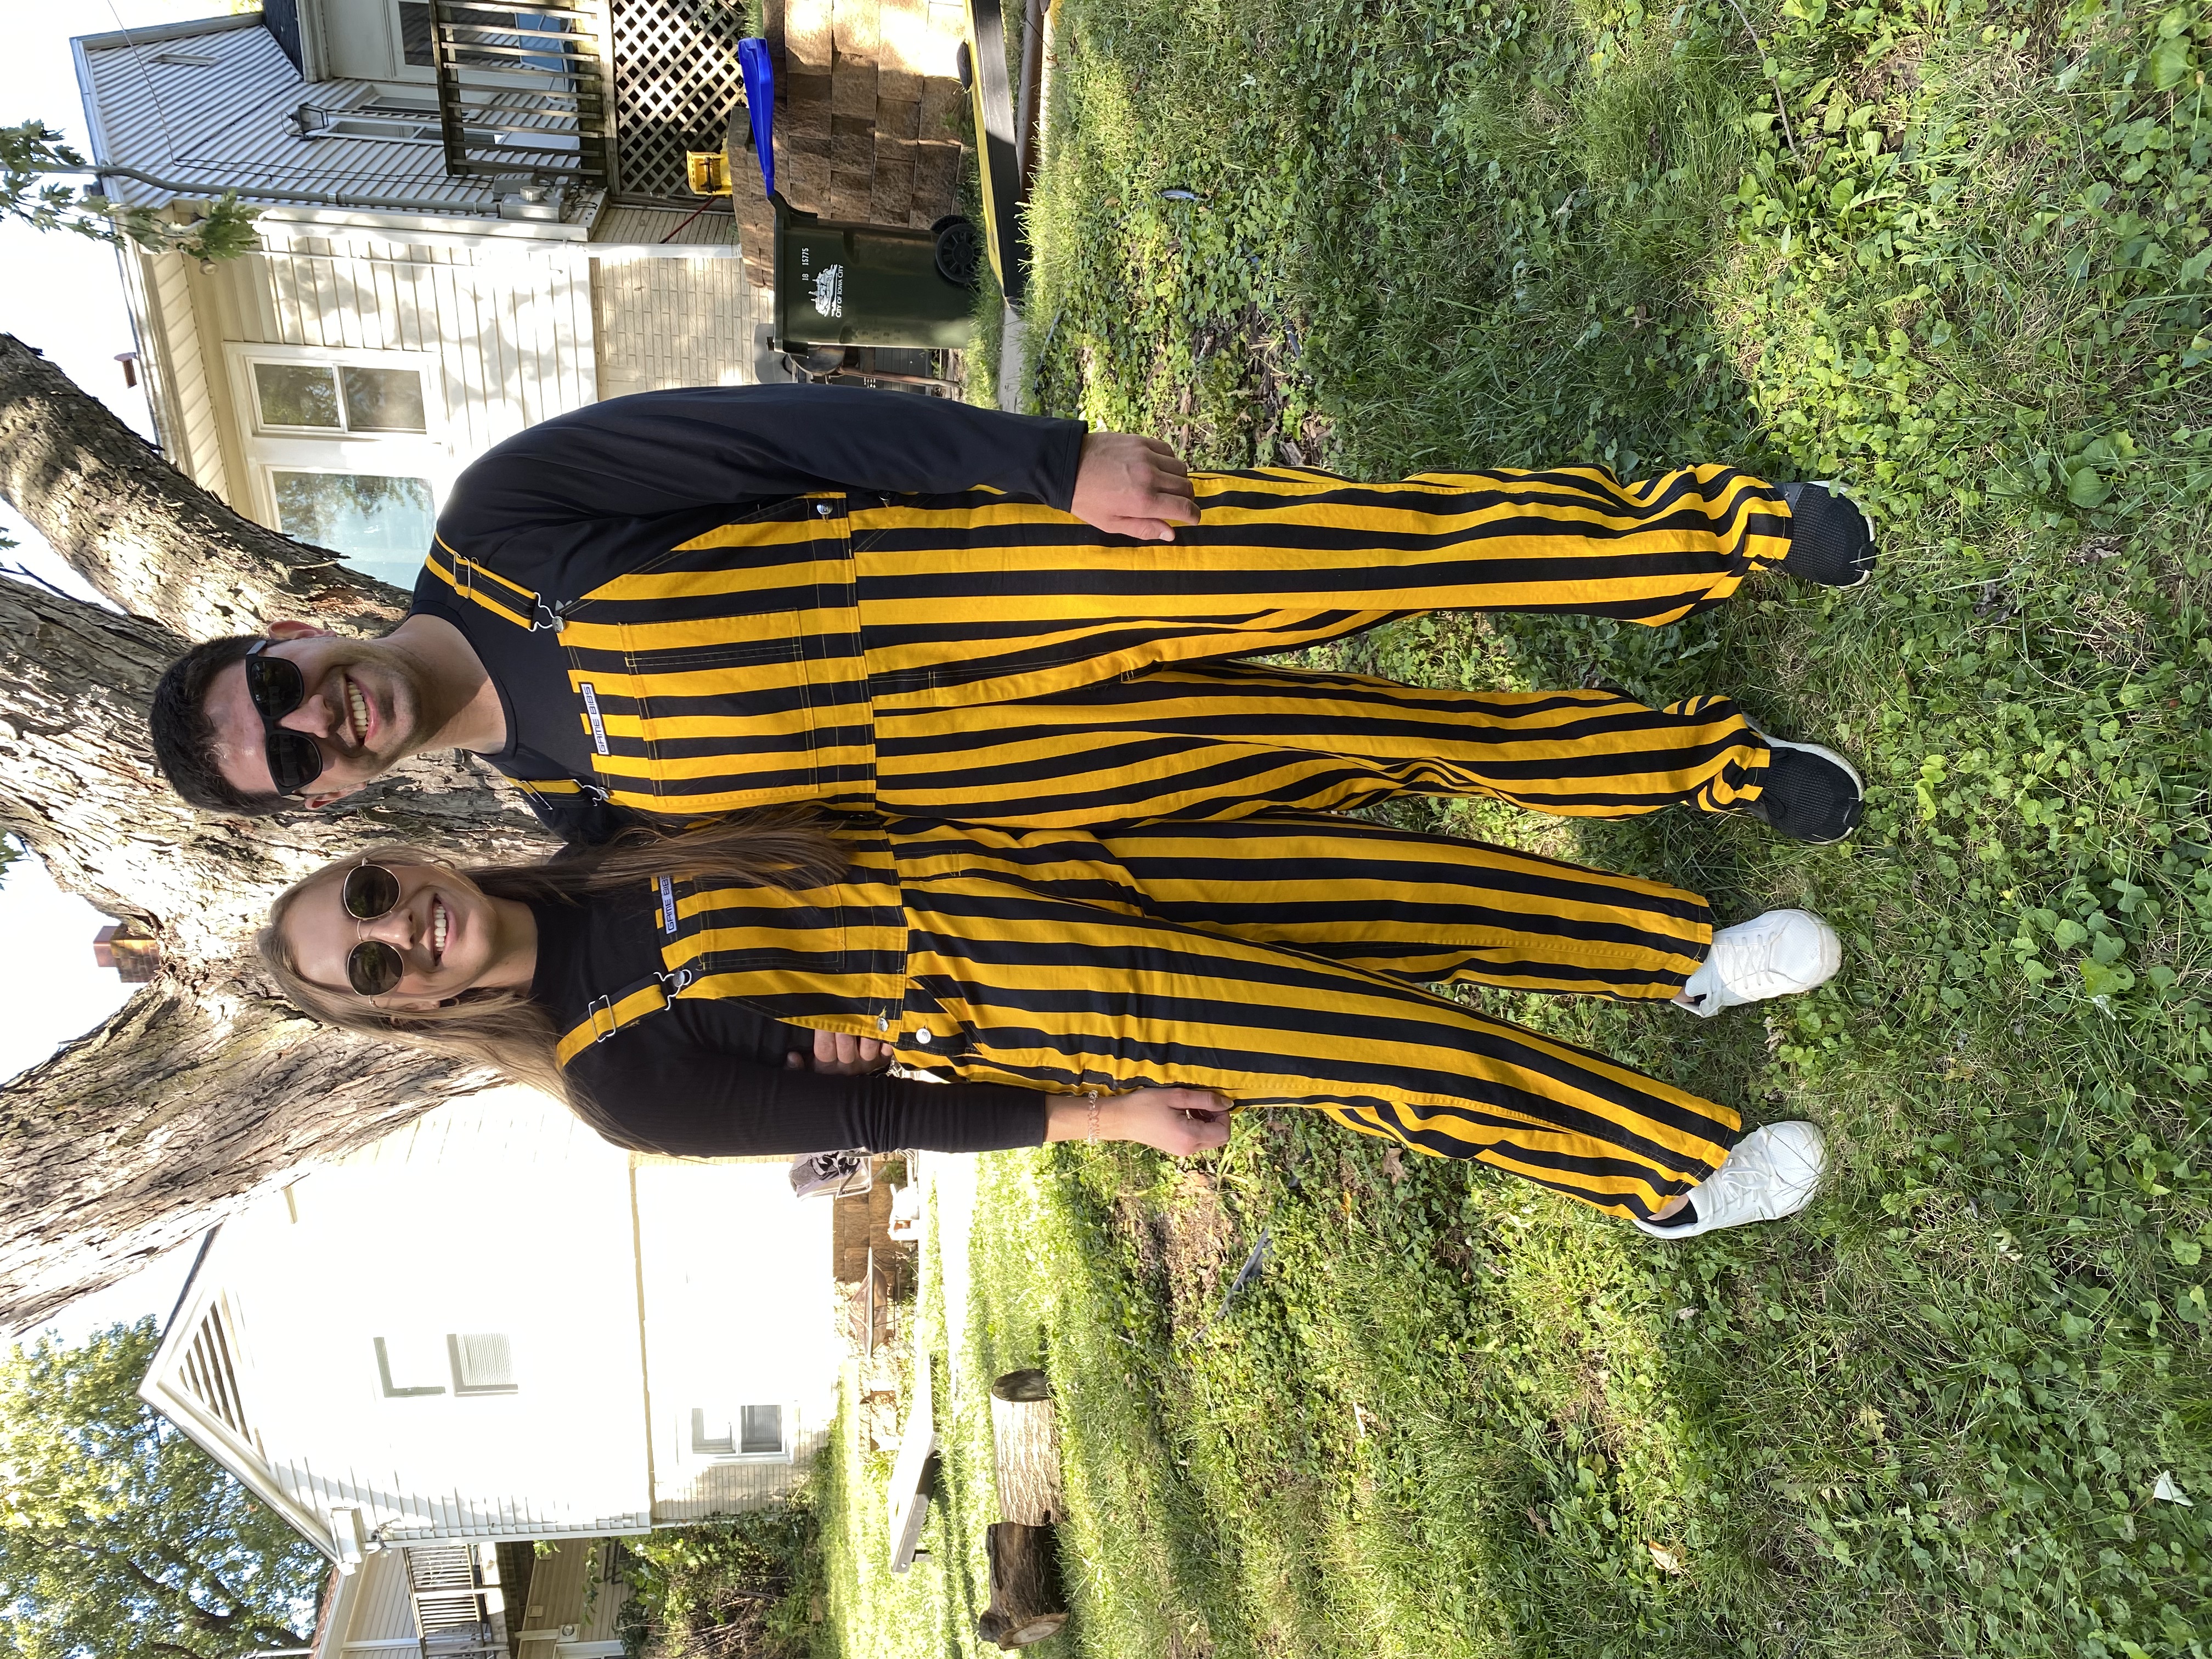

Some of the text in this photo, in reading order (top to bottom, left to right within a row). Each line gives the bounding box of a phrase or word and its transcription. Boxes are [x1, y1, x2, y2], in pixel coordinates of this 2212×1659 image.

[836, 296, 842, 304] OF
[583, 686, 606, 753] GAME BIBS
[664, 898, 674, 931] GAME
